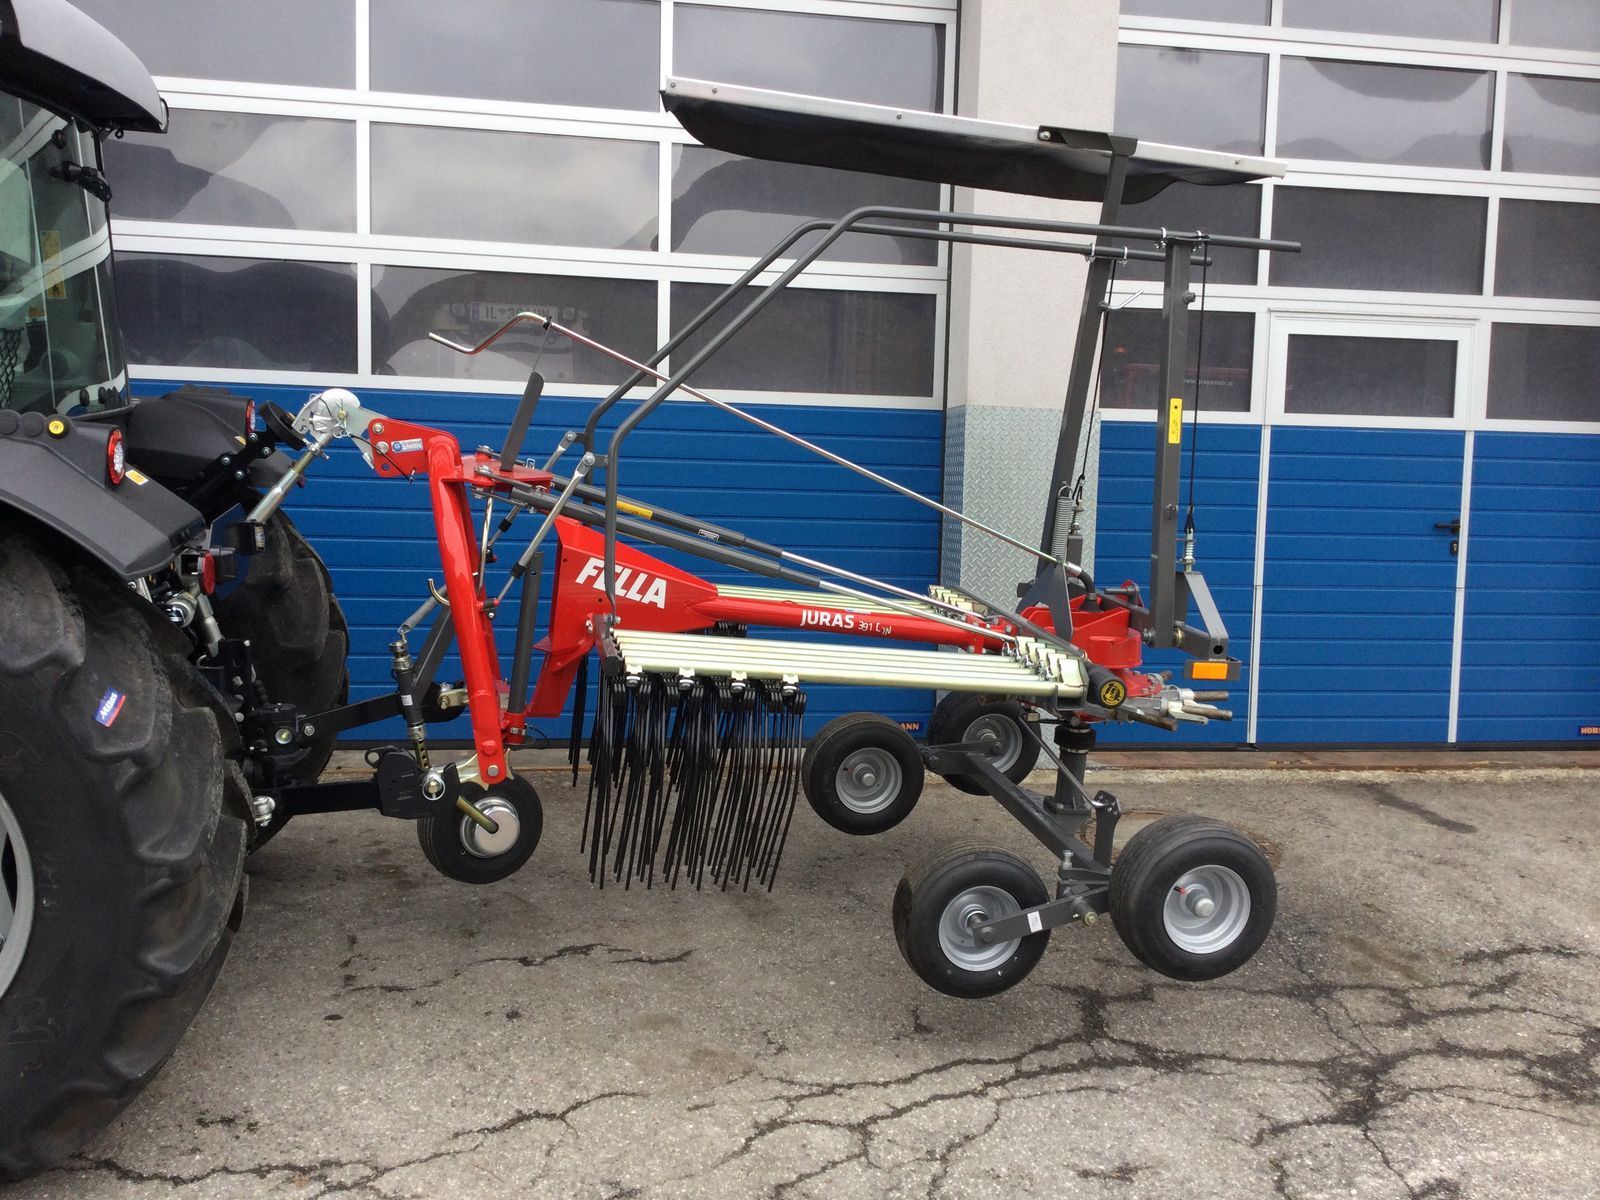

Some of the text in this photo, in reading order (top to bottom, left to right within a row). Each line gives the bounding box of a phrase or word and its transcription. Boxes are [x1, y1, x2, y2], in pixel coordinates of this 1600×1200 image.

[800, 609, 855, 629] JURAS
[858, 621, 873, 632] 391
[900, 722, 920, 730] ANN
